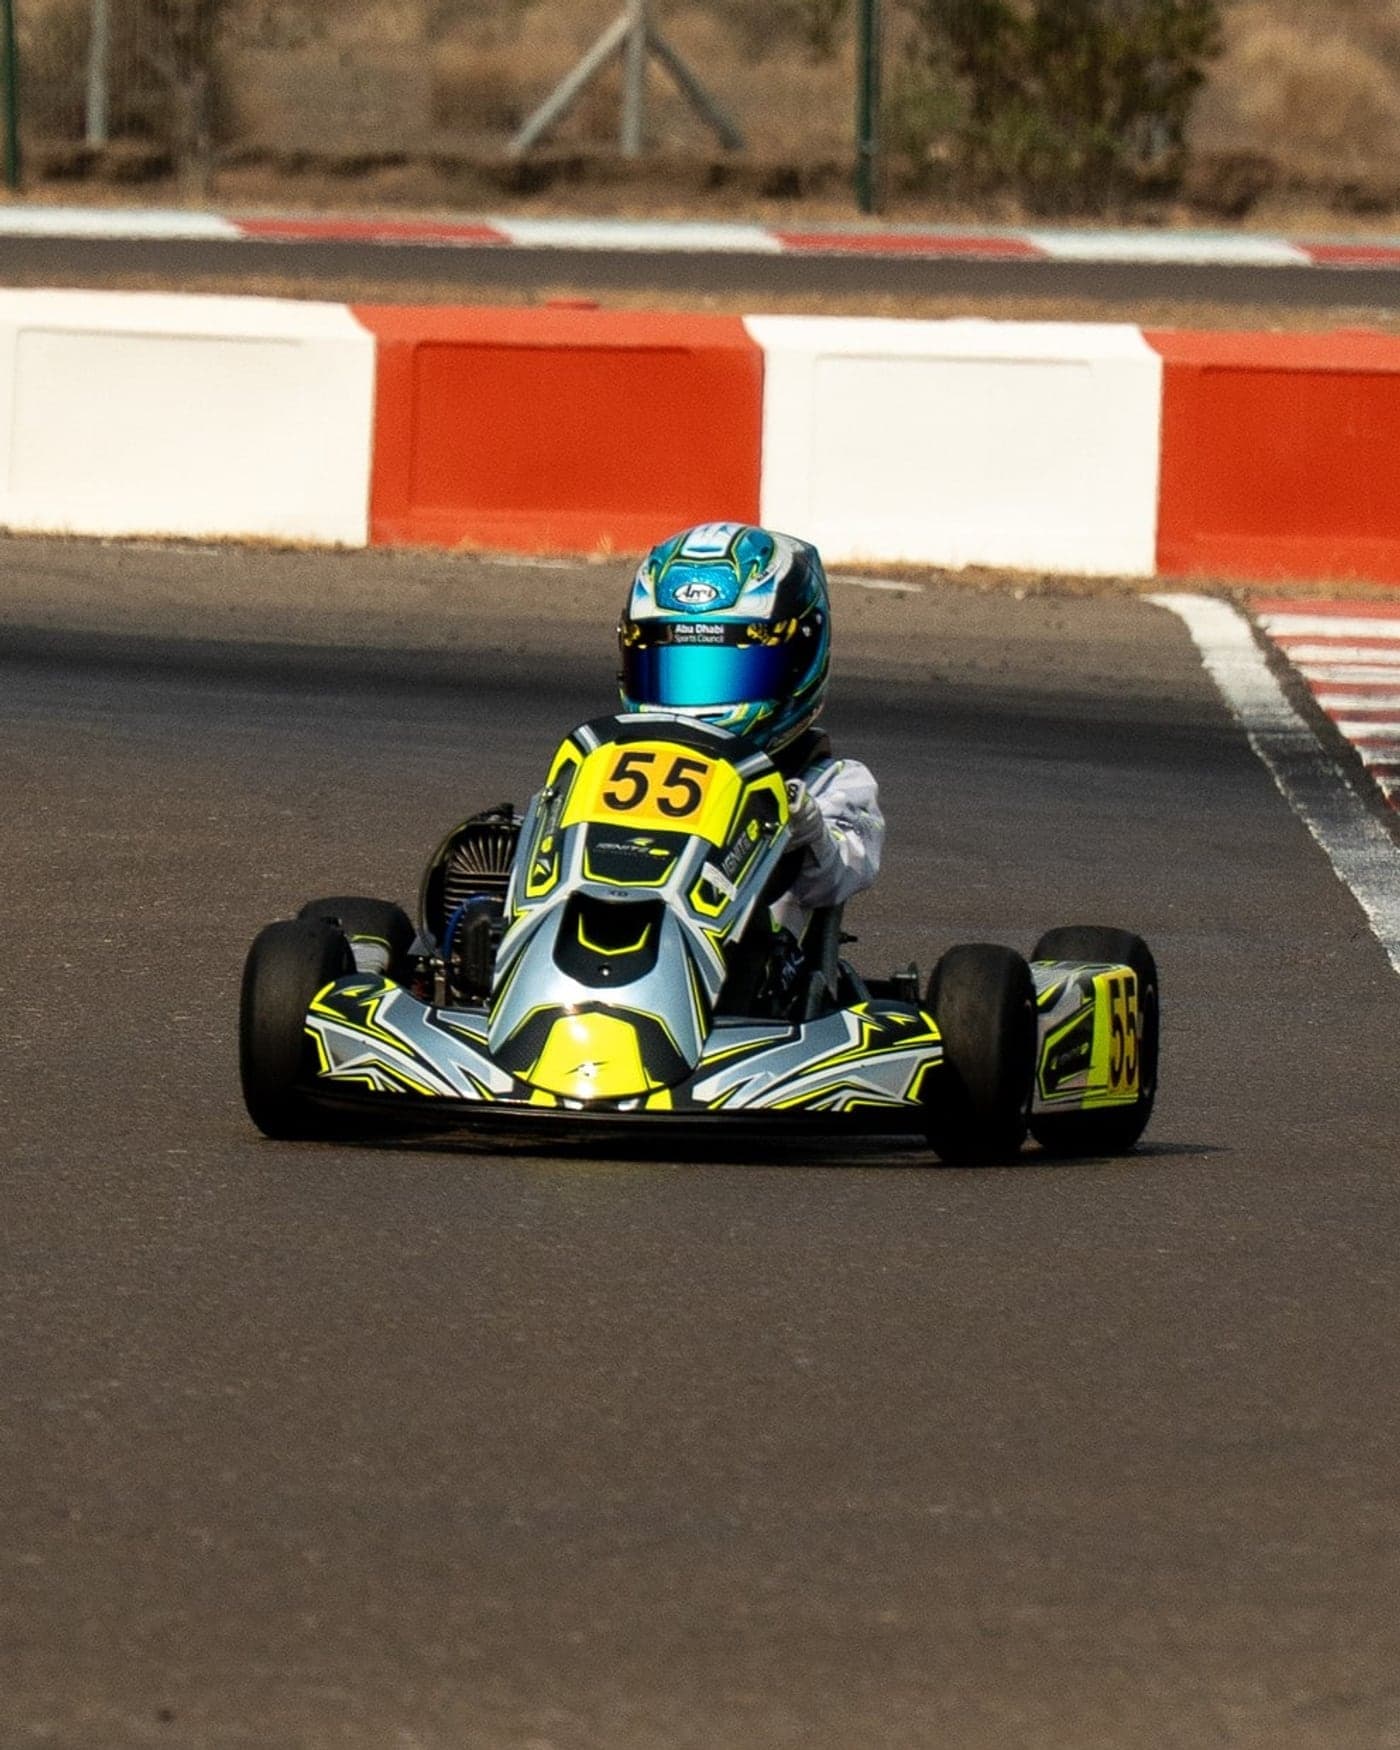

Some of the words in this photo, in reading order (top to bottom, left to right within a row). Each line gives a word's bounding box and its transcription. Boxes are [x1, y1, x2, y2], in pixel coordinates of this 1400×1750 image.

[675, 624, 693, 634] Abu
[696, 624, 724, 634] Dhabi
[675, 634, 697, 643] Sports
[698, 634, 724, 643] Council
[603, 751, 708, 817] 55
[1109, 977, 1136, 1087] 55
